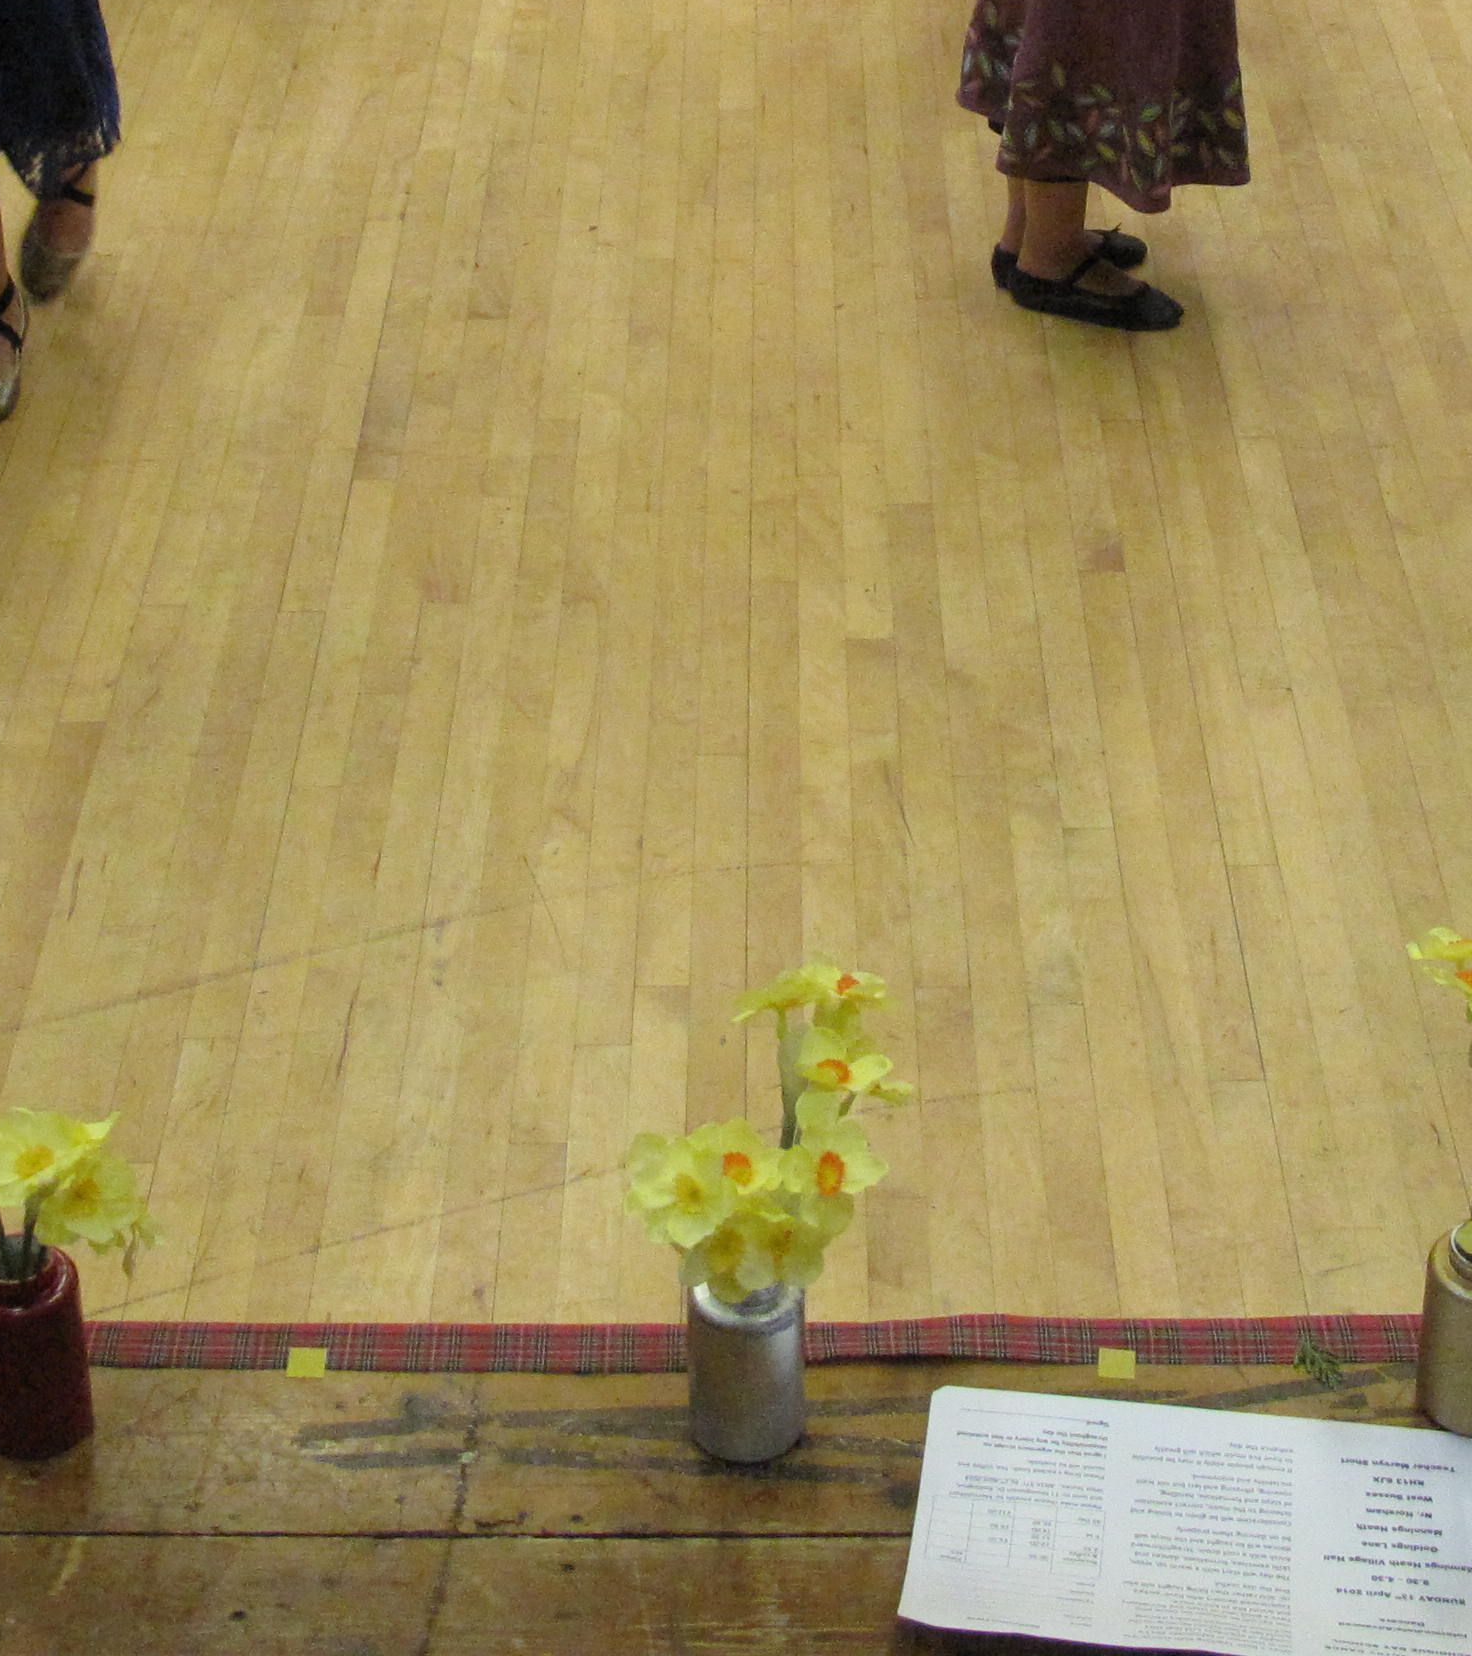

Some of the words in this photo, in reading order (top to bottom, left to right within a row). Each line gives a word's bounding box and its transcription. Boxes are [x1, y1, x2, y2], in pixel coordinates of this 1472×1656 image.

[1413, 1464, 1455, 1472] Teacher
[1392, 1526, 1442, 1536] Mannings
[1324, 1554, 1345, 1562] Hall
[1348, 1556, 1385, 1565] Village
[1389, 1560, 1421, 1568] Heath
[1366, 1590, 1391, 1598] April
[1418, 1595, 1466, 1605] SUNDAY
